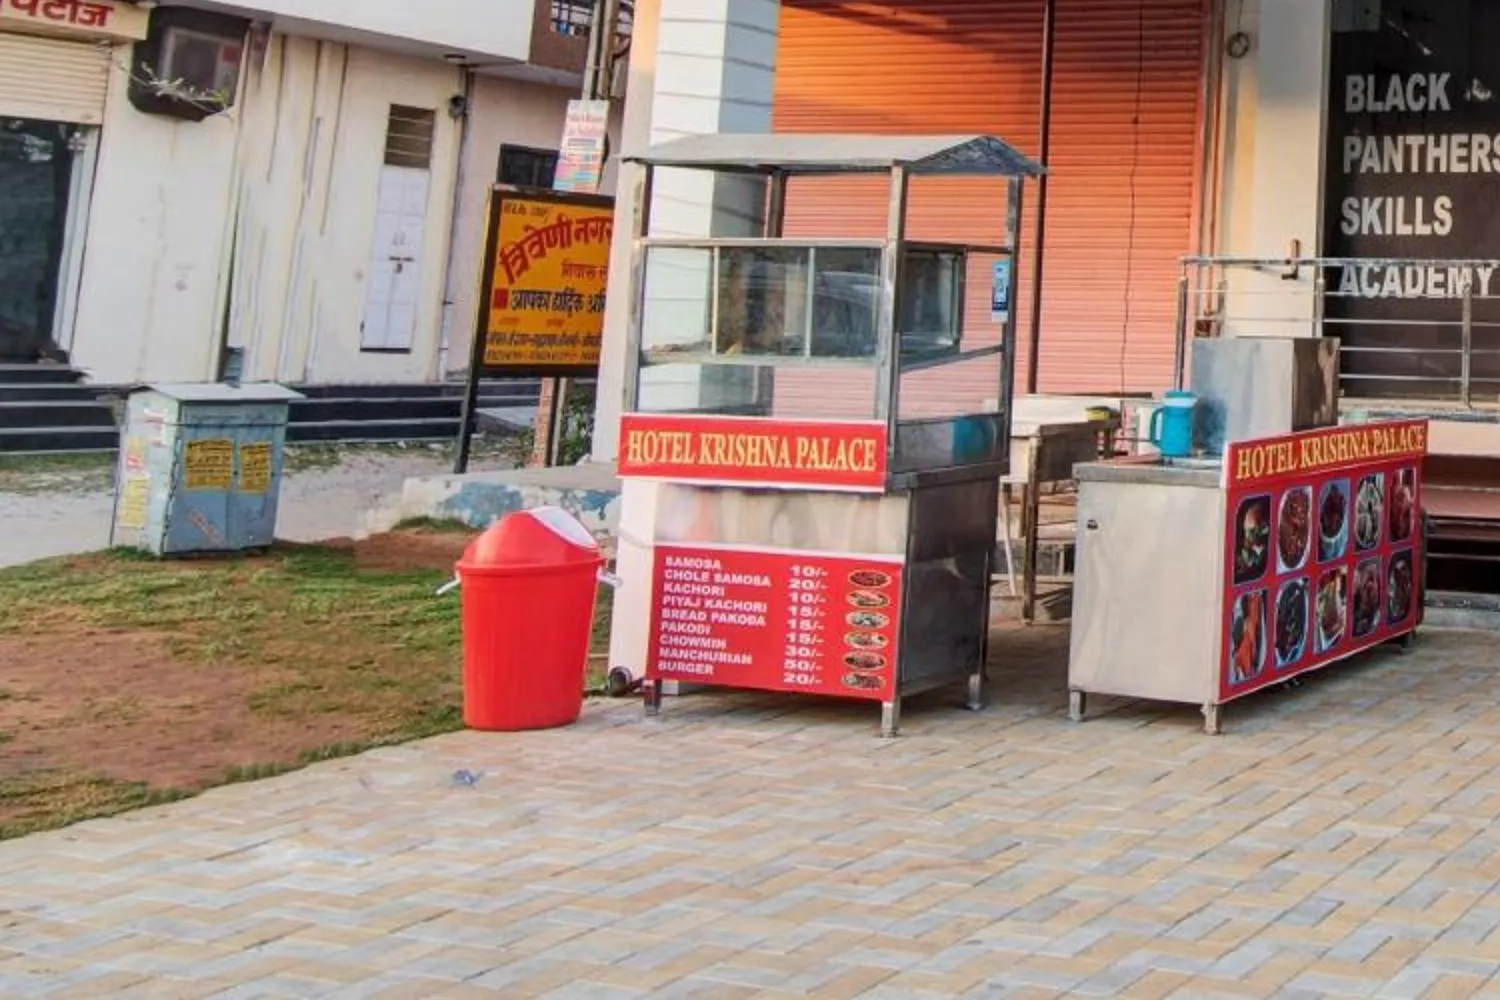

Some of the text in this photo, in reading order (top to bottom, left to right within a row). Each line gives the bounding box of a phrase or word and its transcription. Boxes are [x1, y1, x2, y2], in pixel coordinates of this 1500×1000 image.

[1345, 73, 1451, 112] BLACK
[1340, 196, 1453, 236] SKILLS
[1337, 261, 1498, 299] ACADEMY
[627, 430, 877, 472] HOTEL KRISHNA PALACE
[1236, 424, 1425, 480] HOTEL KRISHNA PALACE
[665, 556, 829, 577] SAMOSA 10/-
[664, 569, 829, 590] CHOLE SAMOSA 20/-
[662, 595, 701, 607] PIYAJ
[704, 599, 767, 613] KACHORI
[663, 582, 827, 604] KACHORI 10/-
[661, 608, 707, 621] BREAD
[660, 634, 727, 649] CHOWMIN
[658, 660, 823, 685] BURGER 20/-
